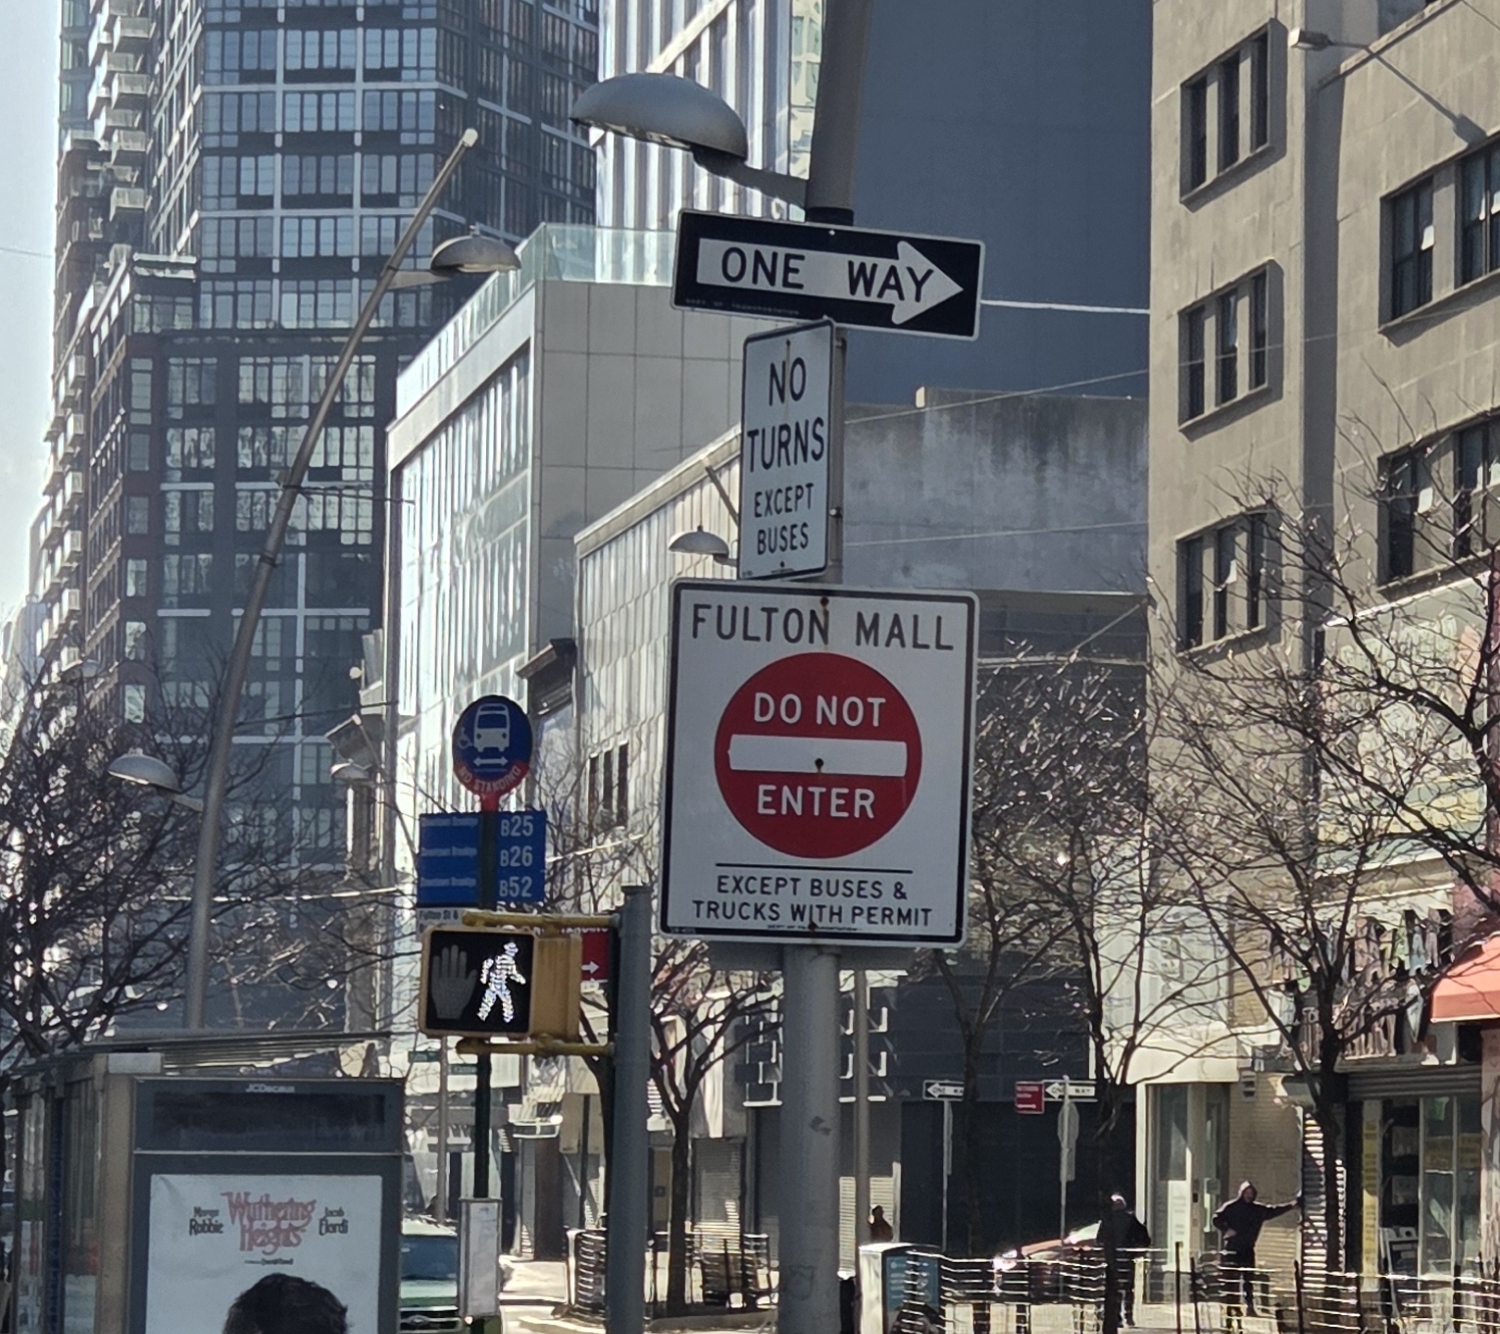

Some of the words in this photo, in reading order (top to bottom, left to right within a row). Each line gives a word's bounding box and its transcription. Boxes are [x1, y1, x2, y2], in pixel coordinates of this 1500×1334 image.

[720, 246, 806, 291] ONE
[846, 258, 935, 304] WAY
[768, 356, 808, 408] NO
[746, 415, 825, 474] TURNS
[753, 482, 815, 519] EXCEPT
[756, 521, 810, 557] BUSES
[691, 602, 831, 646] FULTON
[855, 611, 955, 652] MALL
[753, 691, 802, 726] DO
[816, 694, 888, 728] NOT
[458, 765, 473, 783] NO
[474, 763, 522, 794] STANDING
[756, 783, 877, 820] ENTER
[500, 814, 535, 838] B25
[499, 845, 534, 868] B26
[499, 875, 533, 898] B52
[716, 873, 802, 898] EXCEPT
[809, 877, 884, 900] BUSES
[892, 880, 909, 901] &
[692, 899, 782, 923] TRUCKS
[790, 902, 844, 925] WITH
[850, 904, 934, 928] PERMIT
